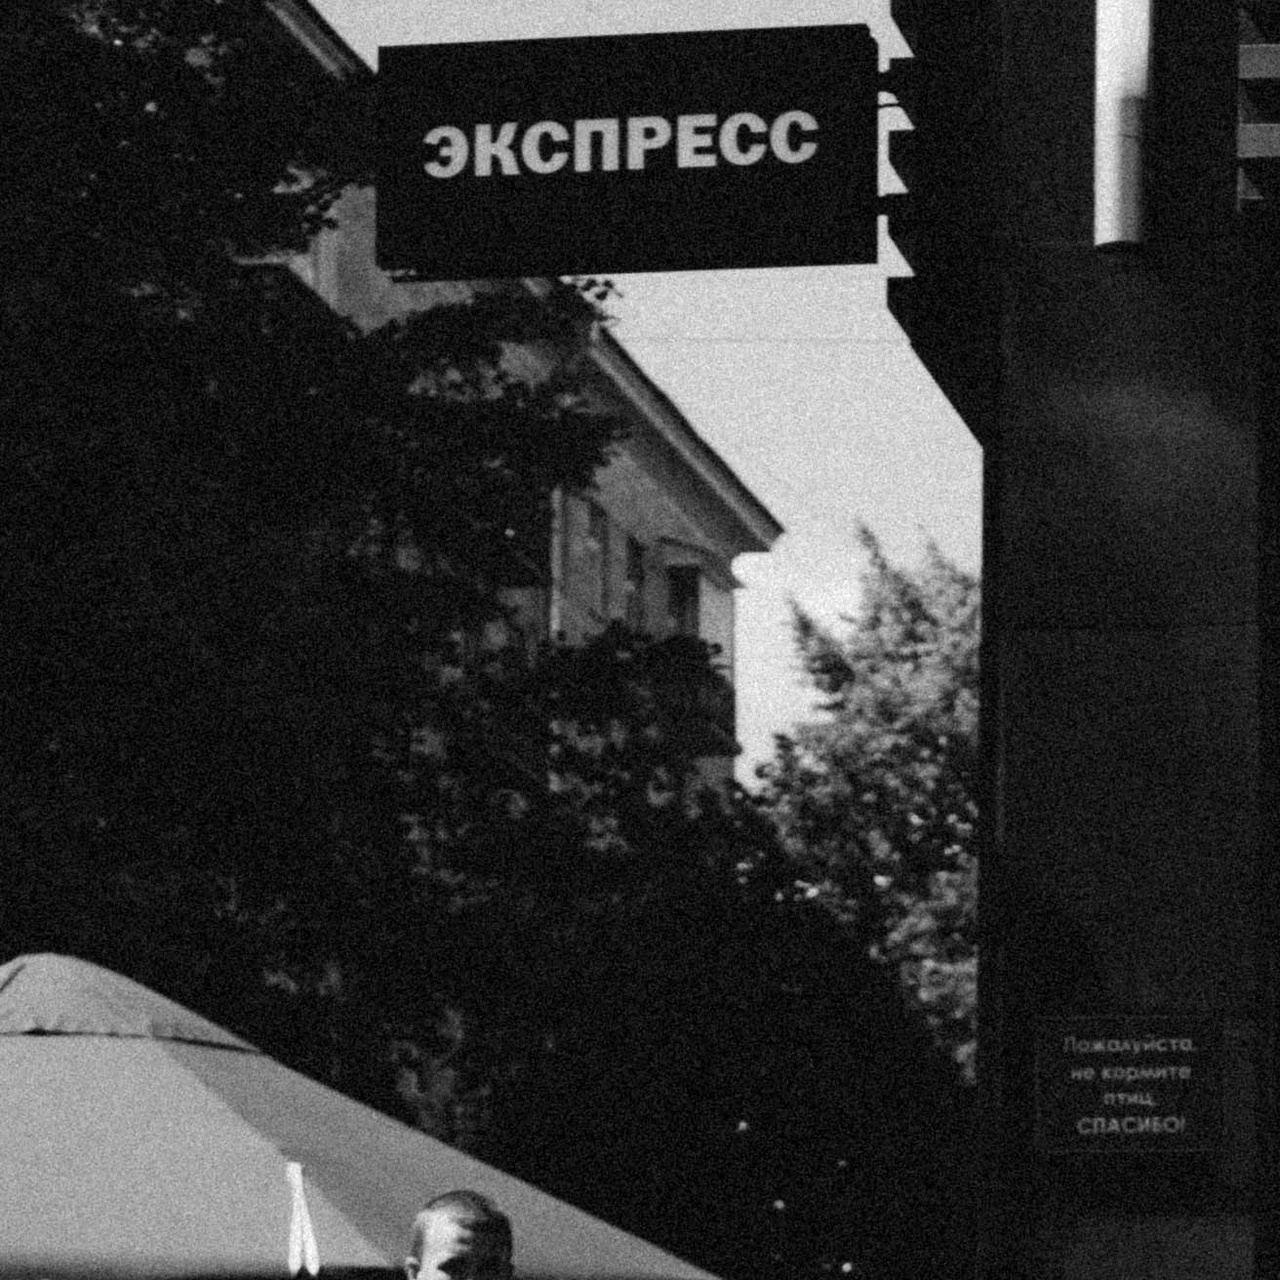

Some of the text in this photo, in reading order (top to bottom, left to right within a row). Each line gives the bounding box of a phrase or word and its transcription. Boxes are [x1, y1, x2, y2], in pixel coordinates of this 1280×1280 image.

[423, 110, 819, 178] ЭКСПРЕСС
[1070, 1066, 1192, 1083] не кормите
[1076, 1115, 1186, 1135] СПАСИБО!
